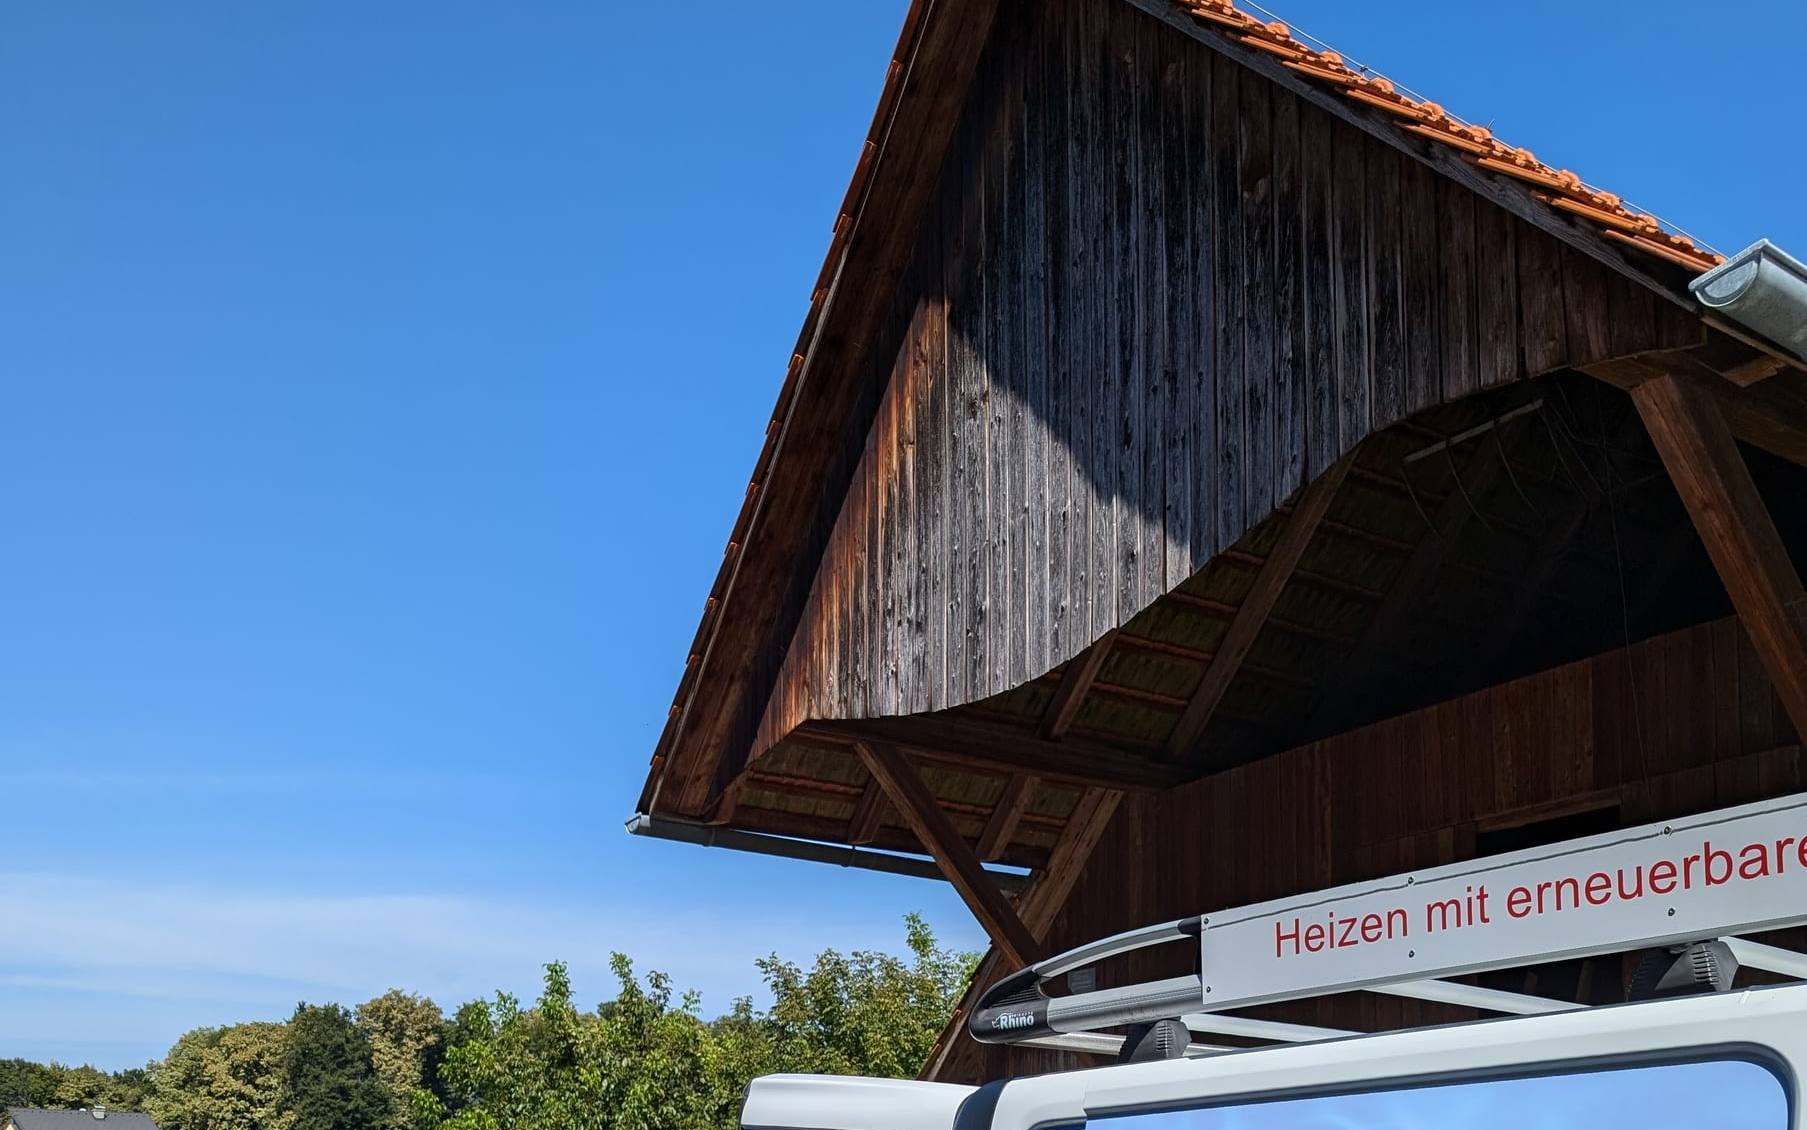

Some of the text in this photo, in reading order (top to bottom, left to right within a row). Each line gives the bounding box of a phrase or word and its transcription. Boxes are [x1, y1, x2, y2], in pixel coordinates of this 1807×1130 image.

[1275, 906, 1409, 958] Heizen
[1426, 885, 1490, 932] mit
[1000, 1011, 1034, 1030] Rhino
